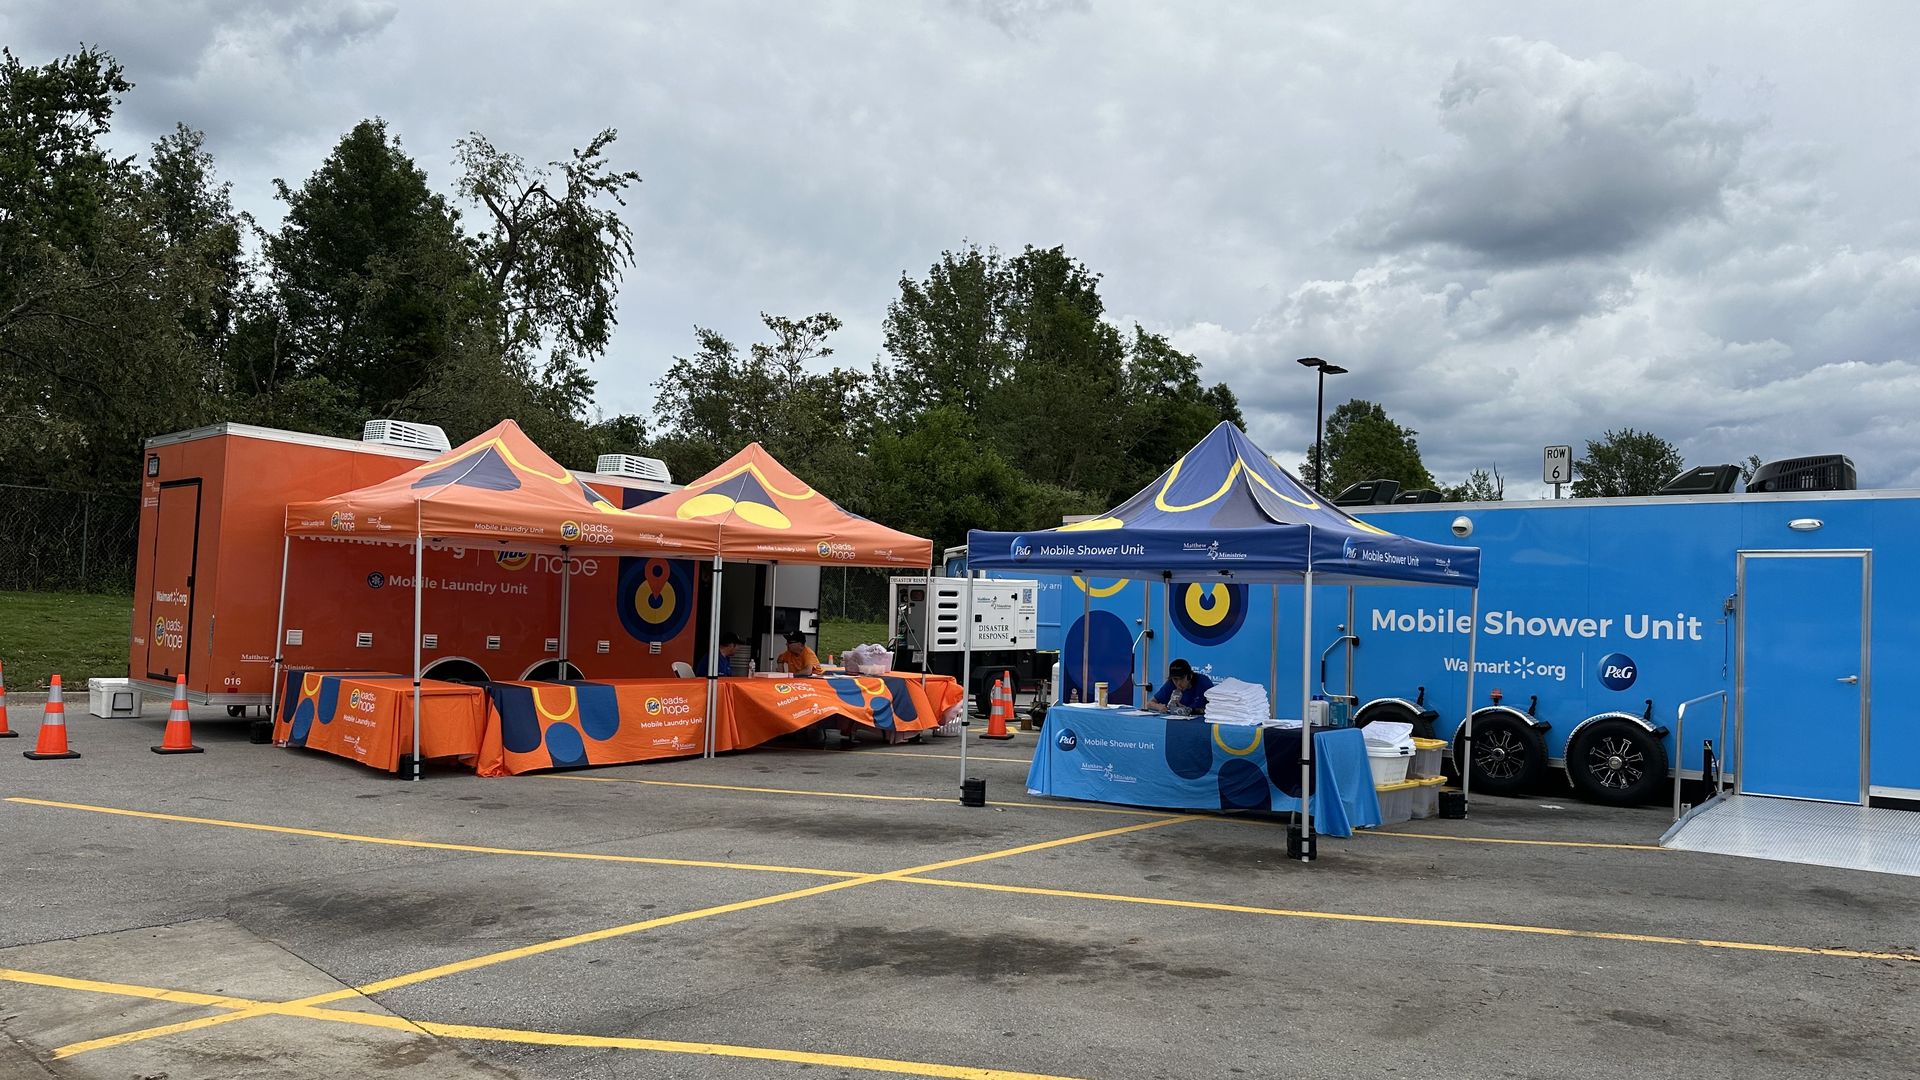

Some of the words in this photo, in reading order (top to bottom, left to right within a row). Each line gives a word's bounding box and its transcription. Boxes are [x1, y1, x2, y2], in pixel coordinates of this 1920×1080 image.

[1547, 449, 1566, 459] ROW
[1552, 465, 1560, 479] 6
[474, 523, 498, 531] Mobile
[500, 525, 529, 534] Laundry
[581, 522, 608, 533] loads
[581, 531, 614, 544] hope
[831, 542, 851, 550] loads
[1015, 546, 1031, 556] P&G
[1040, 546, 1075, 555] Mobile
[1077, 545, 1118, 555] Shower
[1121, 544, 1144, 555] Unit
[832, 551, 856, 560] hope
[1362, 549, 1383, 562] Mobile
[1384, 552, 1406, 565] Shower
[1407, 555, 1419, 567] Unit
[389, 576, 437, 589] Mobile
[442, 579, 497, 595] Laundry
[501, 583, 528, 595] Unit
[156, 591, 173, 602] Walmart
[166, 618, 180, 632] loads
[1372, 609, 1472, 633] Mobile
[1484, 610, 1613, 637] Shower
[1624, 613, 1702, 640] Unit
[165, 633, 183, 651] hope
[1444, 657, 1510, 674] Wamart
[1536, 665, 1566, 681] org
[1604, 665, 1633, 680] P&G
[224, 677, 241, 685] 016
[661, 696, 684, 705] loads
[662, 704, 689, 716] hope
[1059, 736, 1075, 745] P&G
[1084, 738, 1108, 747] Mobile
[1109, 739, 1136, 749] Shower
[1138, 742, 1154, 750] Unit
